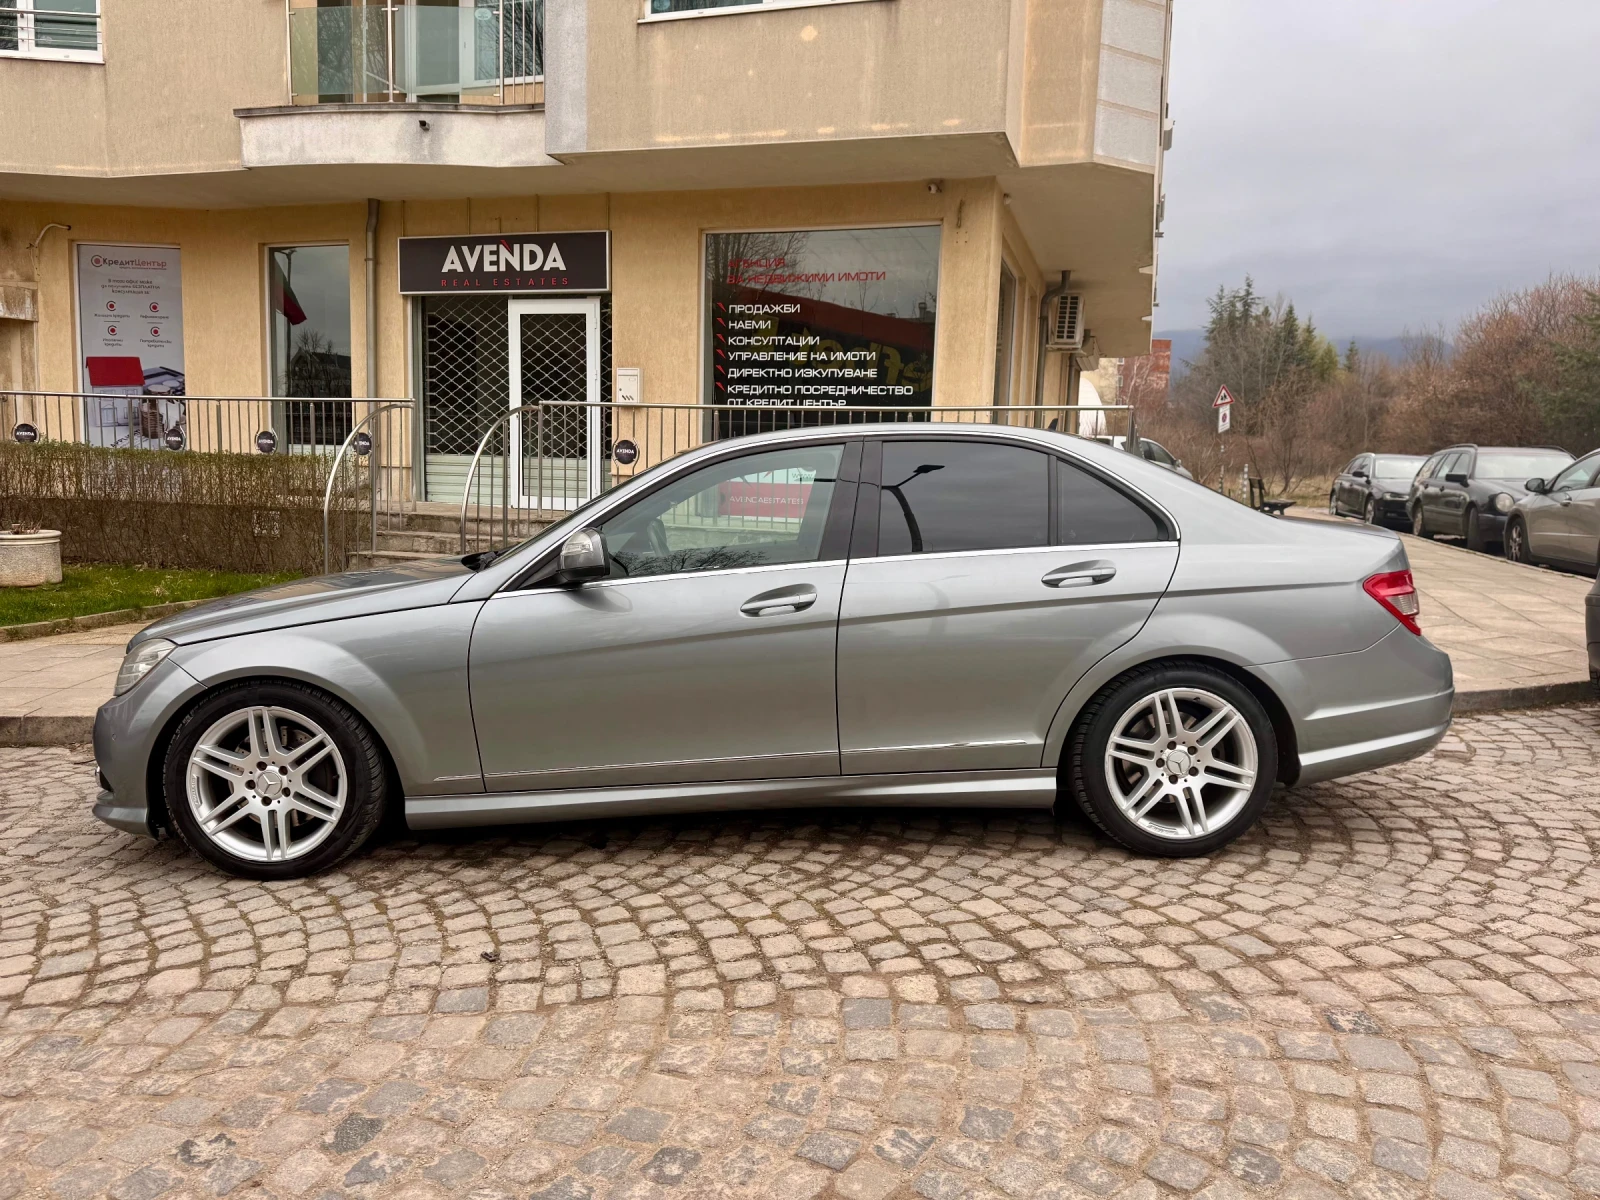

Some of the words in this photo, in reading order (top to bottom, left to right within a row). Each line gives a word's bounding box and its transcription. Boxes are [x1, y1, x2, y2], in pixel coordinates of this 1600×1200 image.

[441, 240, 567, 273] AVENDA
[103, 258, 167, 268] КредитЦентър
[728, 258, 786, 269] АГЕНЦИЯ
[441, 278, 481, 287] REAL
[493, 277, 569, 287] ESTATES
[727, 275, 744, 285] ЗА
[747, 272, 835, 285] НЕДВИЖИМИ
[837, 271, 886, 282] ИМОТИ
[728, 304, 801, 316] ПРОДАЖБИ
[728, 320, 771, 330] НАЕМИ
[728, 336, 820, 347] КОНСУЛТАЦИИ
[728, 351, 807, 361] УПРАВЛЕНИЕ
[810, 351, 827, 361] НА
[830, 351, 876, 361] ИМОТИ
[728, 368, 792, 379] ДИРЕКТНО
[795, 368, 878, 378] ИЗКУПУВАНЕ
[727, 385, 792, 396] КРЕДИТНО
[794, 385, 914, 396] ПОСРЕДНИЧЕСТВО
